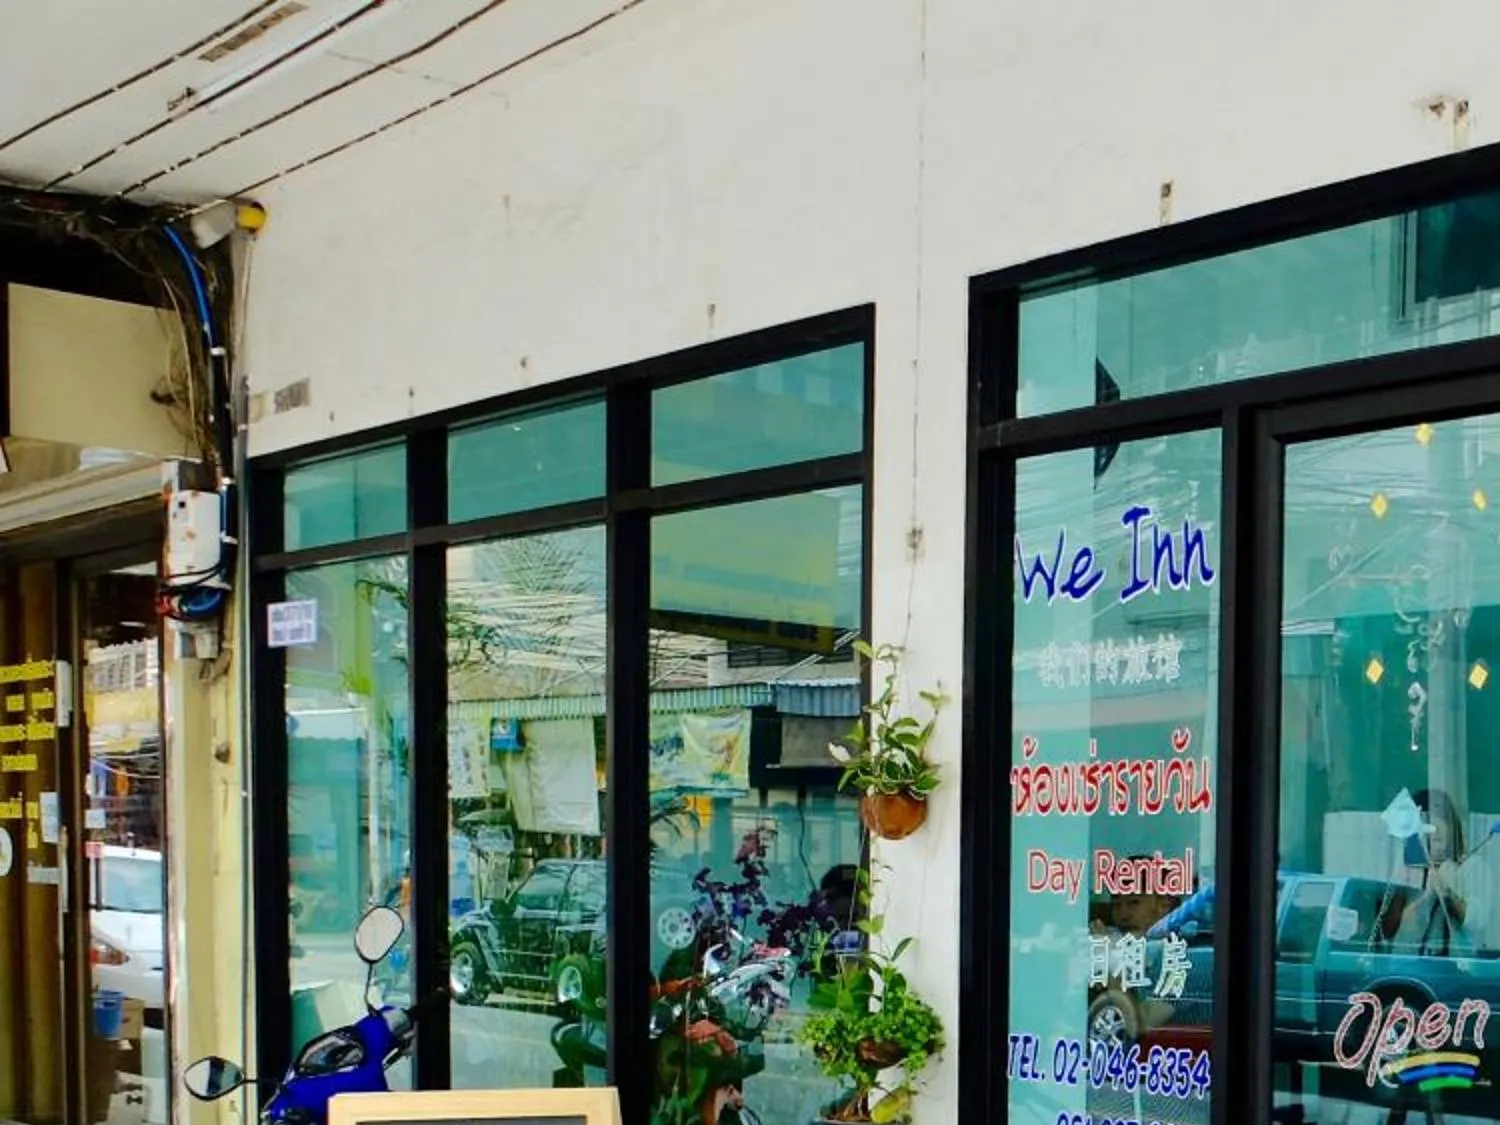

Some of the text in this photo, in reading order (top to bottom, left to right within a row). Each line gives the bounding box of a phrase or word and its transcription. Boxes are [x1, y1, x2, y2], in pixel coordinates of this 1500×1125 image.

[1014, 505, 1216, 605] We Inn
[1027, 848, 1194, 906] Day Rental
[1087, 932, 1192, 998] 日租房
[1008, 1034, 1211, 1099] TEL. 02-046-8354
[1334, 992, 1490, 1087] Open
